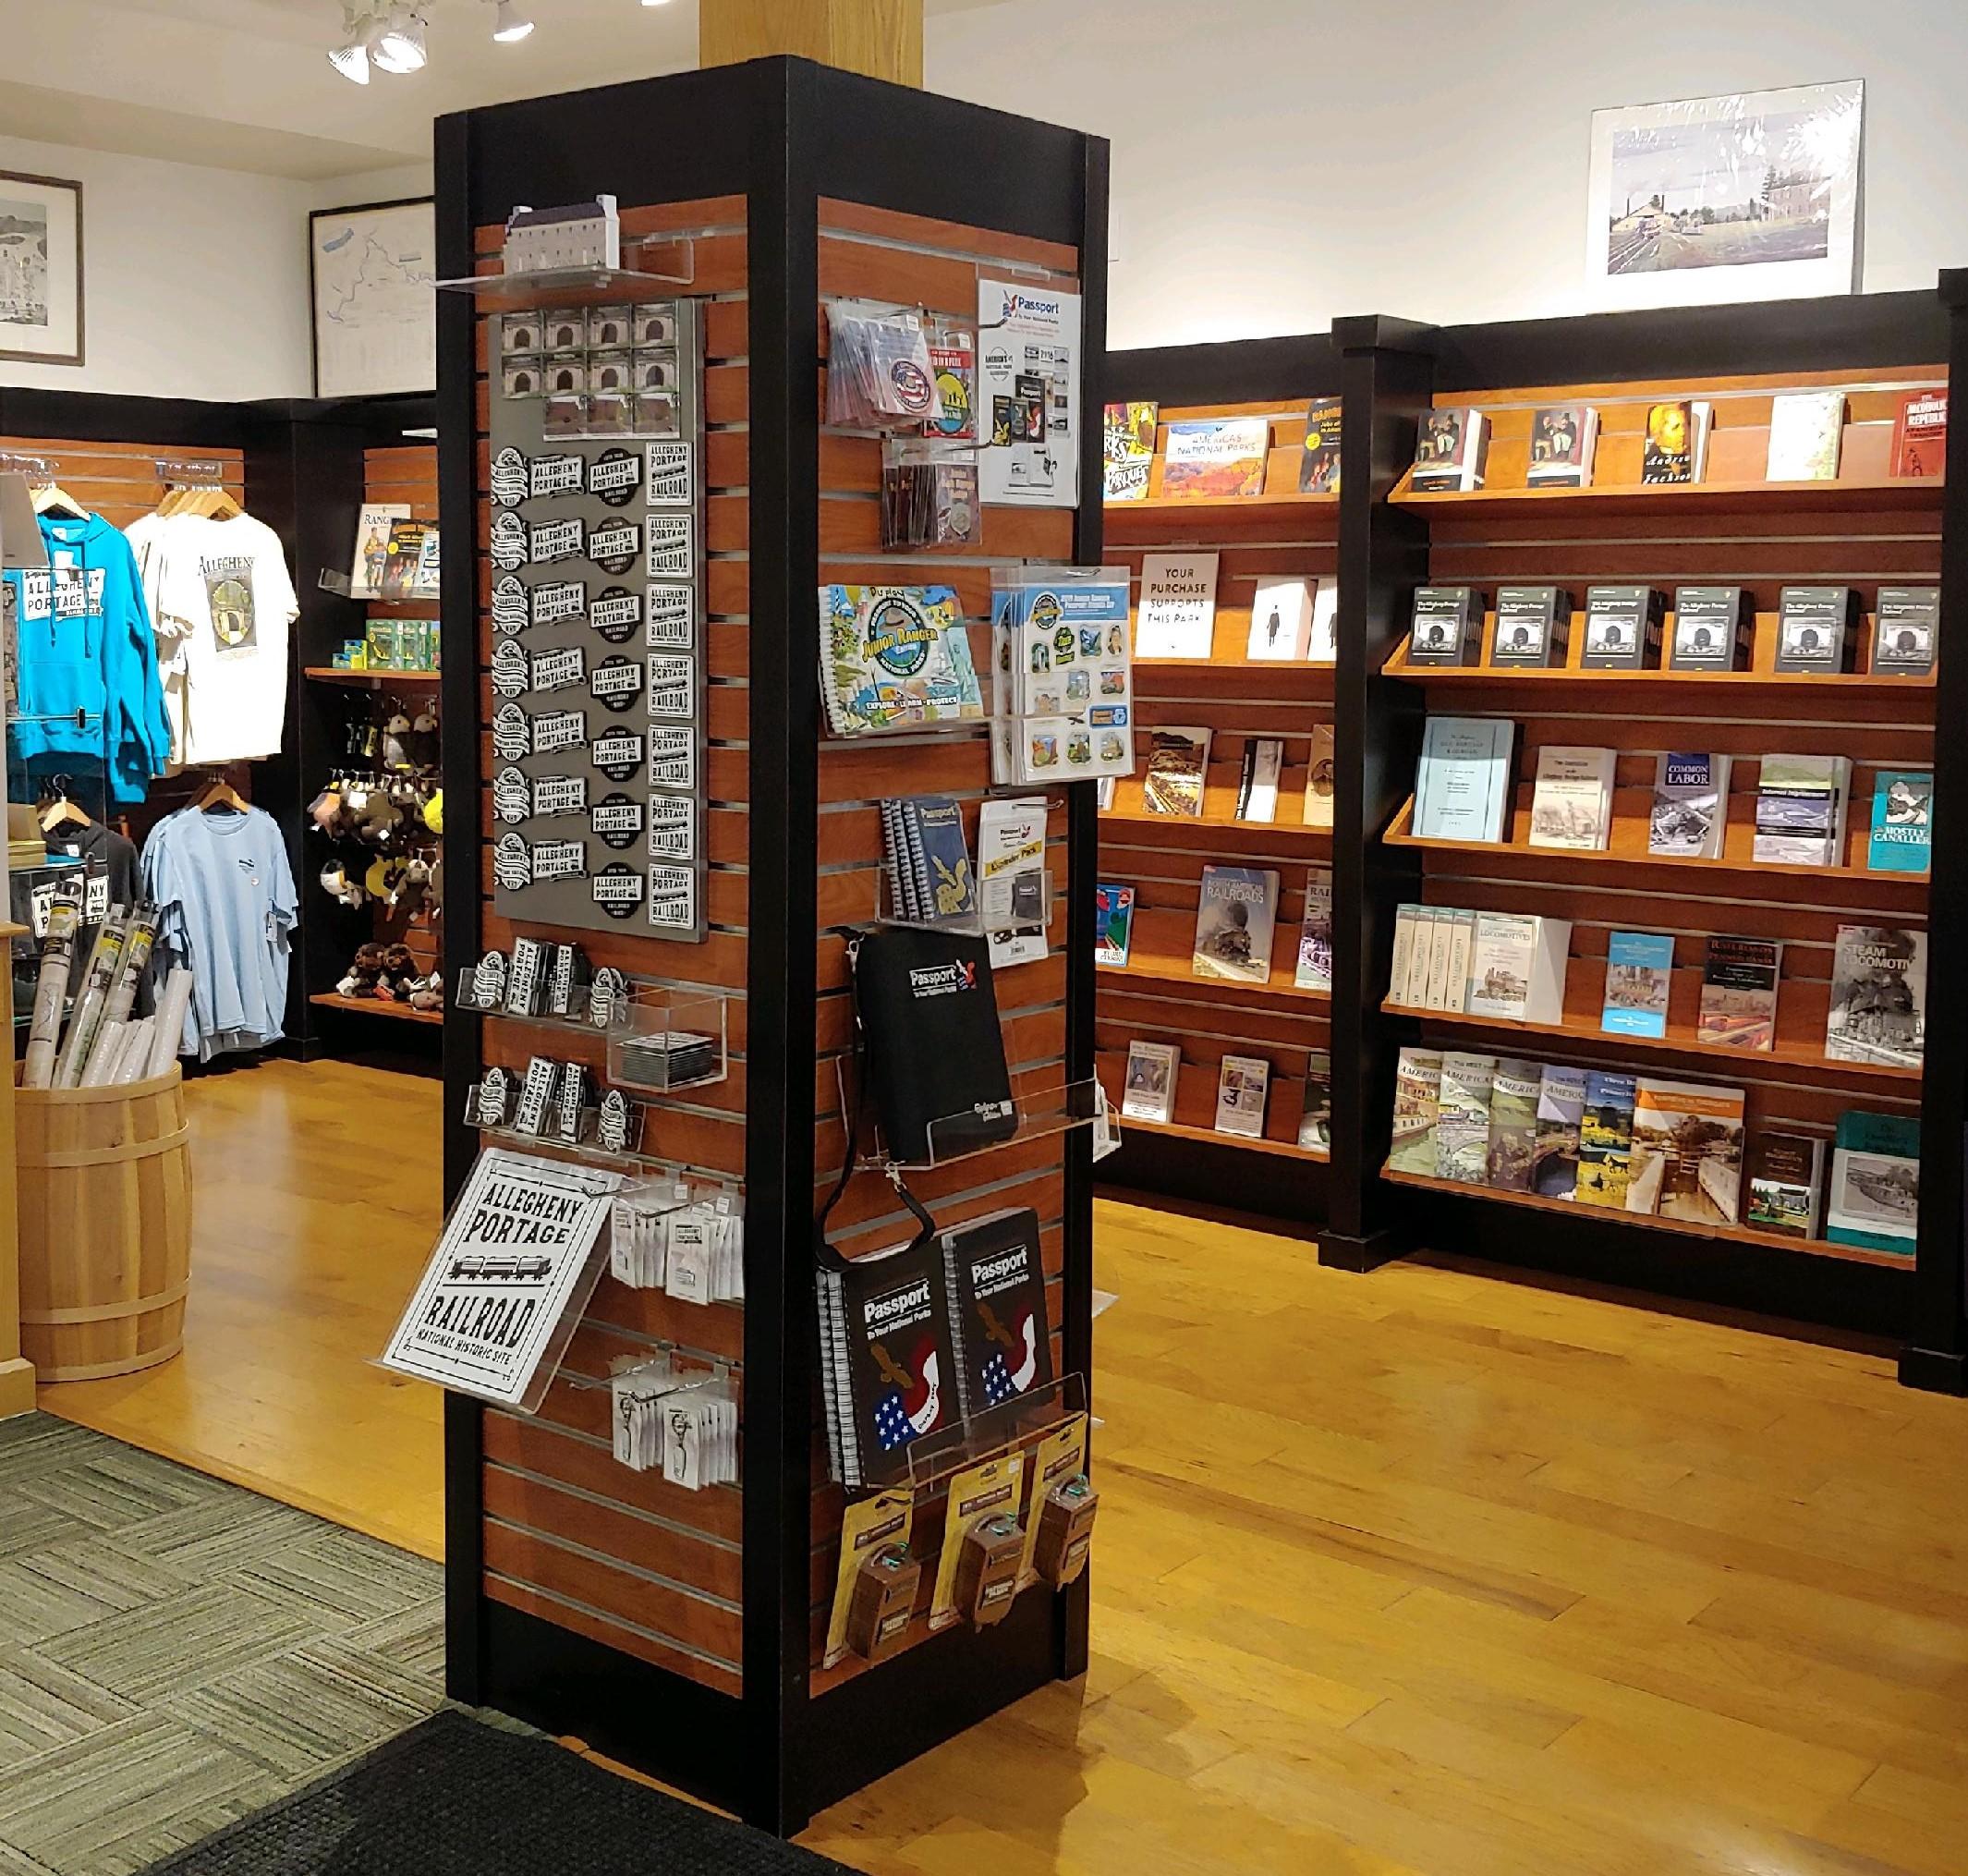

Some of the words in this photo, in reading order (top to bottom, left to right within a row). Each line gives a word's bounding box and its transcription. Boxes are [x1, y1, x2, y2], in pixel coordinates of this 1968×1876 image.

[1018, 296, 1060, 314] Passport
[651, 445, 687, 454] ALLEGHENY
[651, 455, 687, 468] PORTAGE
[535, 462, 578, 478] ALLEGHENY
[593, 461, 633, 477] ALLEGHENY
[534, 477, 566, 491] PORTAGE
[593, 475, 624, 488] PORTAGE
[651, 478, 687, 494] RAILROAD
[650, 519, 687, 529] ALLEGHENY
[535, 525, 578, 543] ALLEGHENY
[592, 530, 632, 546] ALLEGHENY
[650, 529, 687, 541] PORTAGE
[534, 539, 567, 556] PORTAGE
[592, 543, 624, 557] PORTAGE
[650, 552, 687, 567] RAILROAD
[1165, 568, 1194, 579] YOUR
[651, 590, 687, 598] ALLEGHENY
[1150, 583, 1208, 594] PURCHASE
[536, 589, 579, 605] ALLEGHENY
[651, 598, 687, 609] PORTAGE
[536, 603, 569, 618] PORTAGE
[593, 599, 634, 614] ALLEGHENY
[594, 612, 625, 626] PORTAGE
[1148, 613, 1171, 624] THIS
[651, 621, 688, 638] RAILROAD
[862, 632, 895, 663] JUNIOR
[896, 627, 939, 645] RANGER
[536, 654, 579, 673] ALLEGHENY
[651, 659, 688, 669] ALLEGHENY
[536, 669, 568, 687] PORTAGE
[594, 666, 635, 682] ALLEGHENY
[651, 667, 688, 678] PORTAGE
[594, 679, 626, 693] PORTAGE
[651, 692, 688, 709] RAILROAD
[537, 717, 580, 734] ALLEGHENY
[537, 732, 569, 747] PORTAGE
[652, 730, 688, 740] ALLEGHENY
[595, 739, 636, 752] ALLEGHENY
[652, 739, 688, 750] PORTAGE
[595, 750, 626, 763] PORTAGE
[652, 763, 688, 779] RAILROAD
[1668, 765, 1708, 774] COMMON
[1668, 773, 1708, 785] LABOR
[538, 783, 581, 797] ALLEGHENY
[538, 797, 570, 809] PORTAGE
[652, 799, 688, 810] ALLEGHENY
[595, 807, 636, 819] ALLEGHENY
[652, 809, 688, 819] PORTAGE
[595, 818, 626, 830] PORTAGE
[1885, 826, 1927, 837] MOSTLY
[652, 834, 688, 847] RAILROAD
[536, 847, 579, 860] ALLEGHENY
[536, 859, 568, 872] PORTAGE
[652, 870, 688, 880] ALLEGHENY
[596, 878, 637, 887] ALLEGHENY
[652, 878, 688, 889] PORTAGE
[596, 889, 627, 898] PORTAGE
[1207, 887, 1264, 904] RAILROADS
[652, 903, 688, 918] RAILROAD
[1844, 944, 1887, 956] STEAM
[911, 968, 956, 987] Passport
[1402, 1066, 1439, 1078] AMERIC
[1497, 1079, 1539, 1093] AMERIC
[1547, 1085, 1585, 1099] AMERIC
[481, 1183, 585, 1224] ALLEGHENY
[462, 1210, 571, 1245] PORTAGE
[971, 1249, 1027, 1285] Passport
[864, 1284, 930, 1323] Passport
[424, 1296, 537, 1348] RAILROAD
[416, 1328, 456, 1351] NATIONAL
[456, 1340, 492, 1358] HISTORIC
[493, 1350, 514, 1366] SITE
